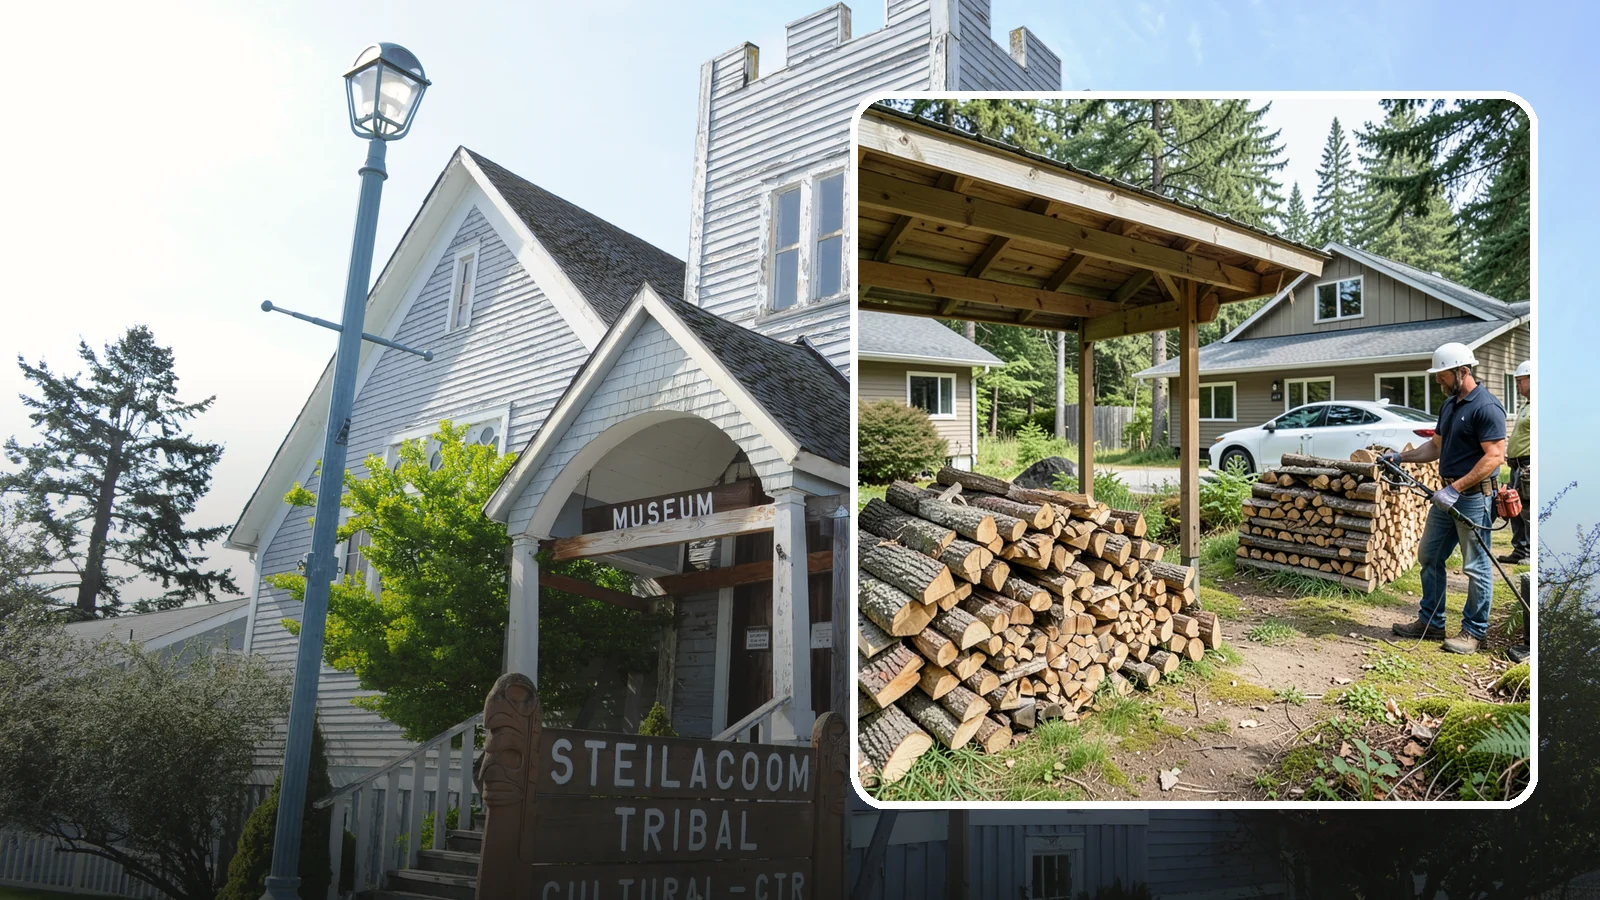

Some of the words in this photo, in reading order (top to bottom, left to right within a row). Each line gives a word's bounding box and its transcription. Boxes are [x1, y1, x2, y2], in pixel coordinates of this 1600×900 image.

[613, 491, 713, 530] MUSEUM
[551, 738, 810, 792] STEILACOOM
[615, 806, 758, 852] TRIBAL
